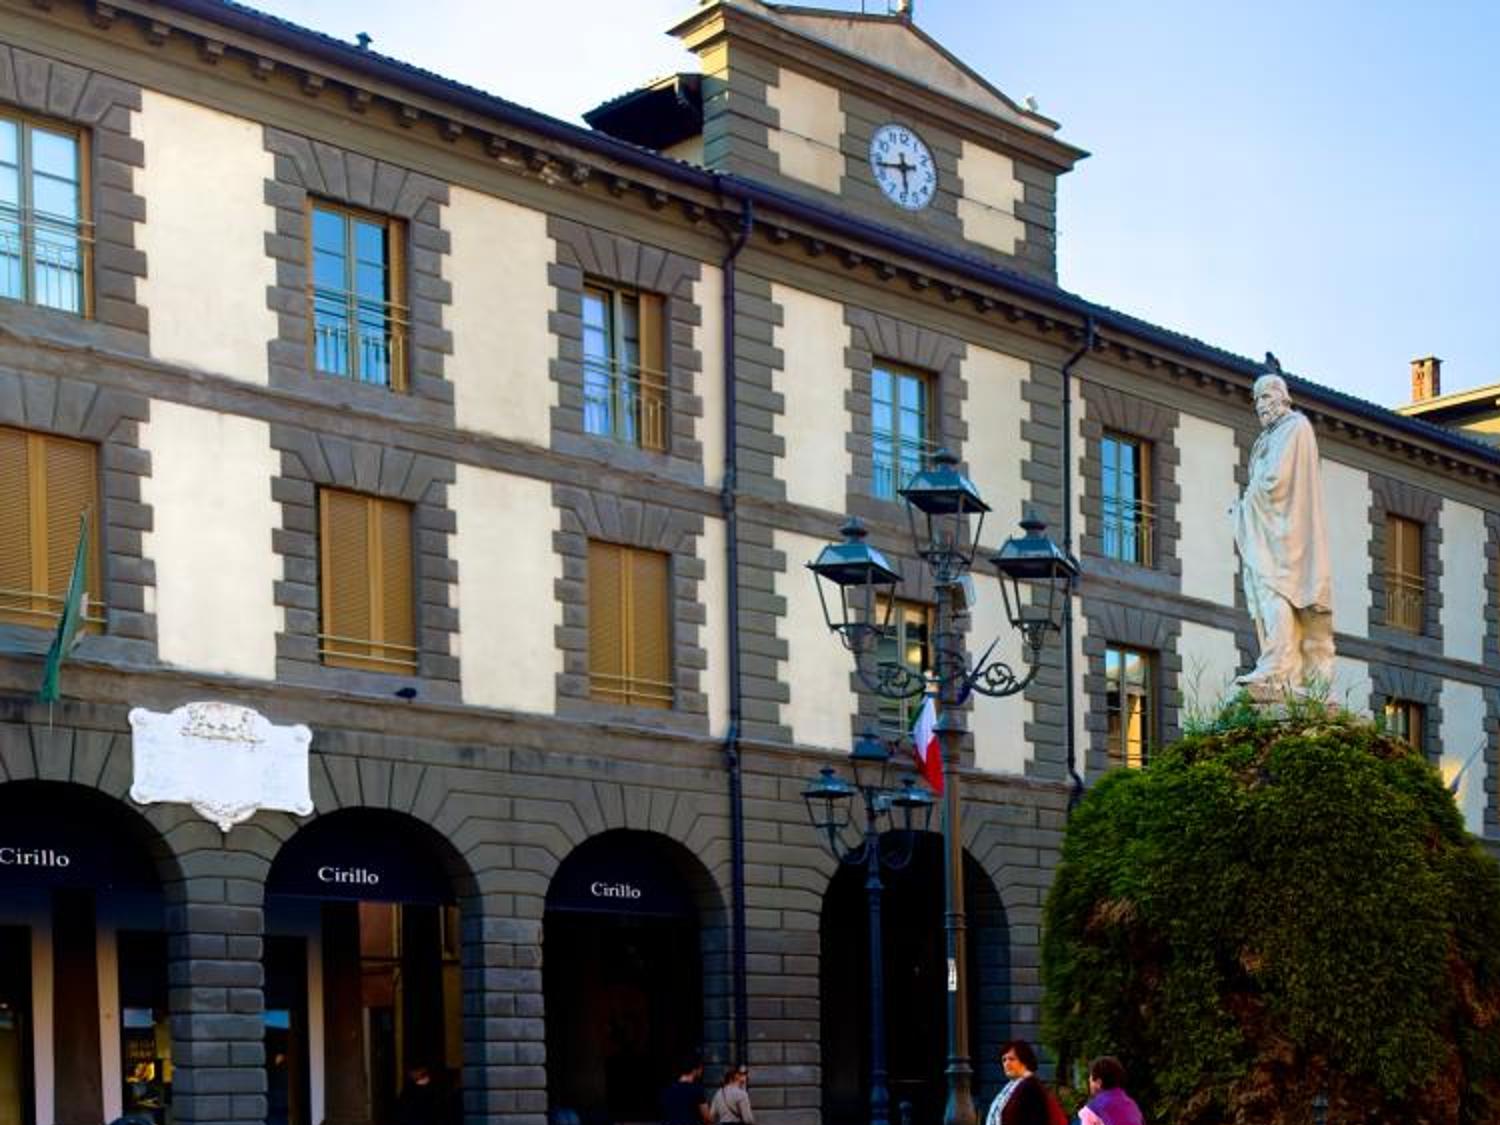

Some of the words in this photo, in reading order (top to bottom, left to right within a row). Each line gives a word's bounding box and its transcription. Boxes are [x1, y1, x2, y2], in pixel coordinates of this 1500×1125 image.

[0, 847, 70, 867] Cirillo
[317, 865, 379, 885] Cirillo
[591, 881, 641, 899] Cirillo
